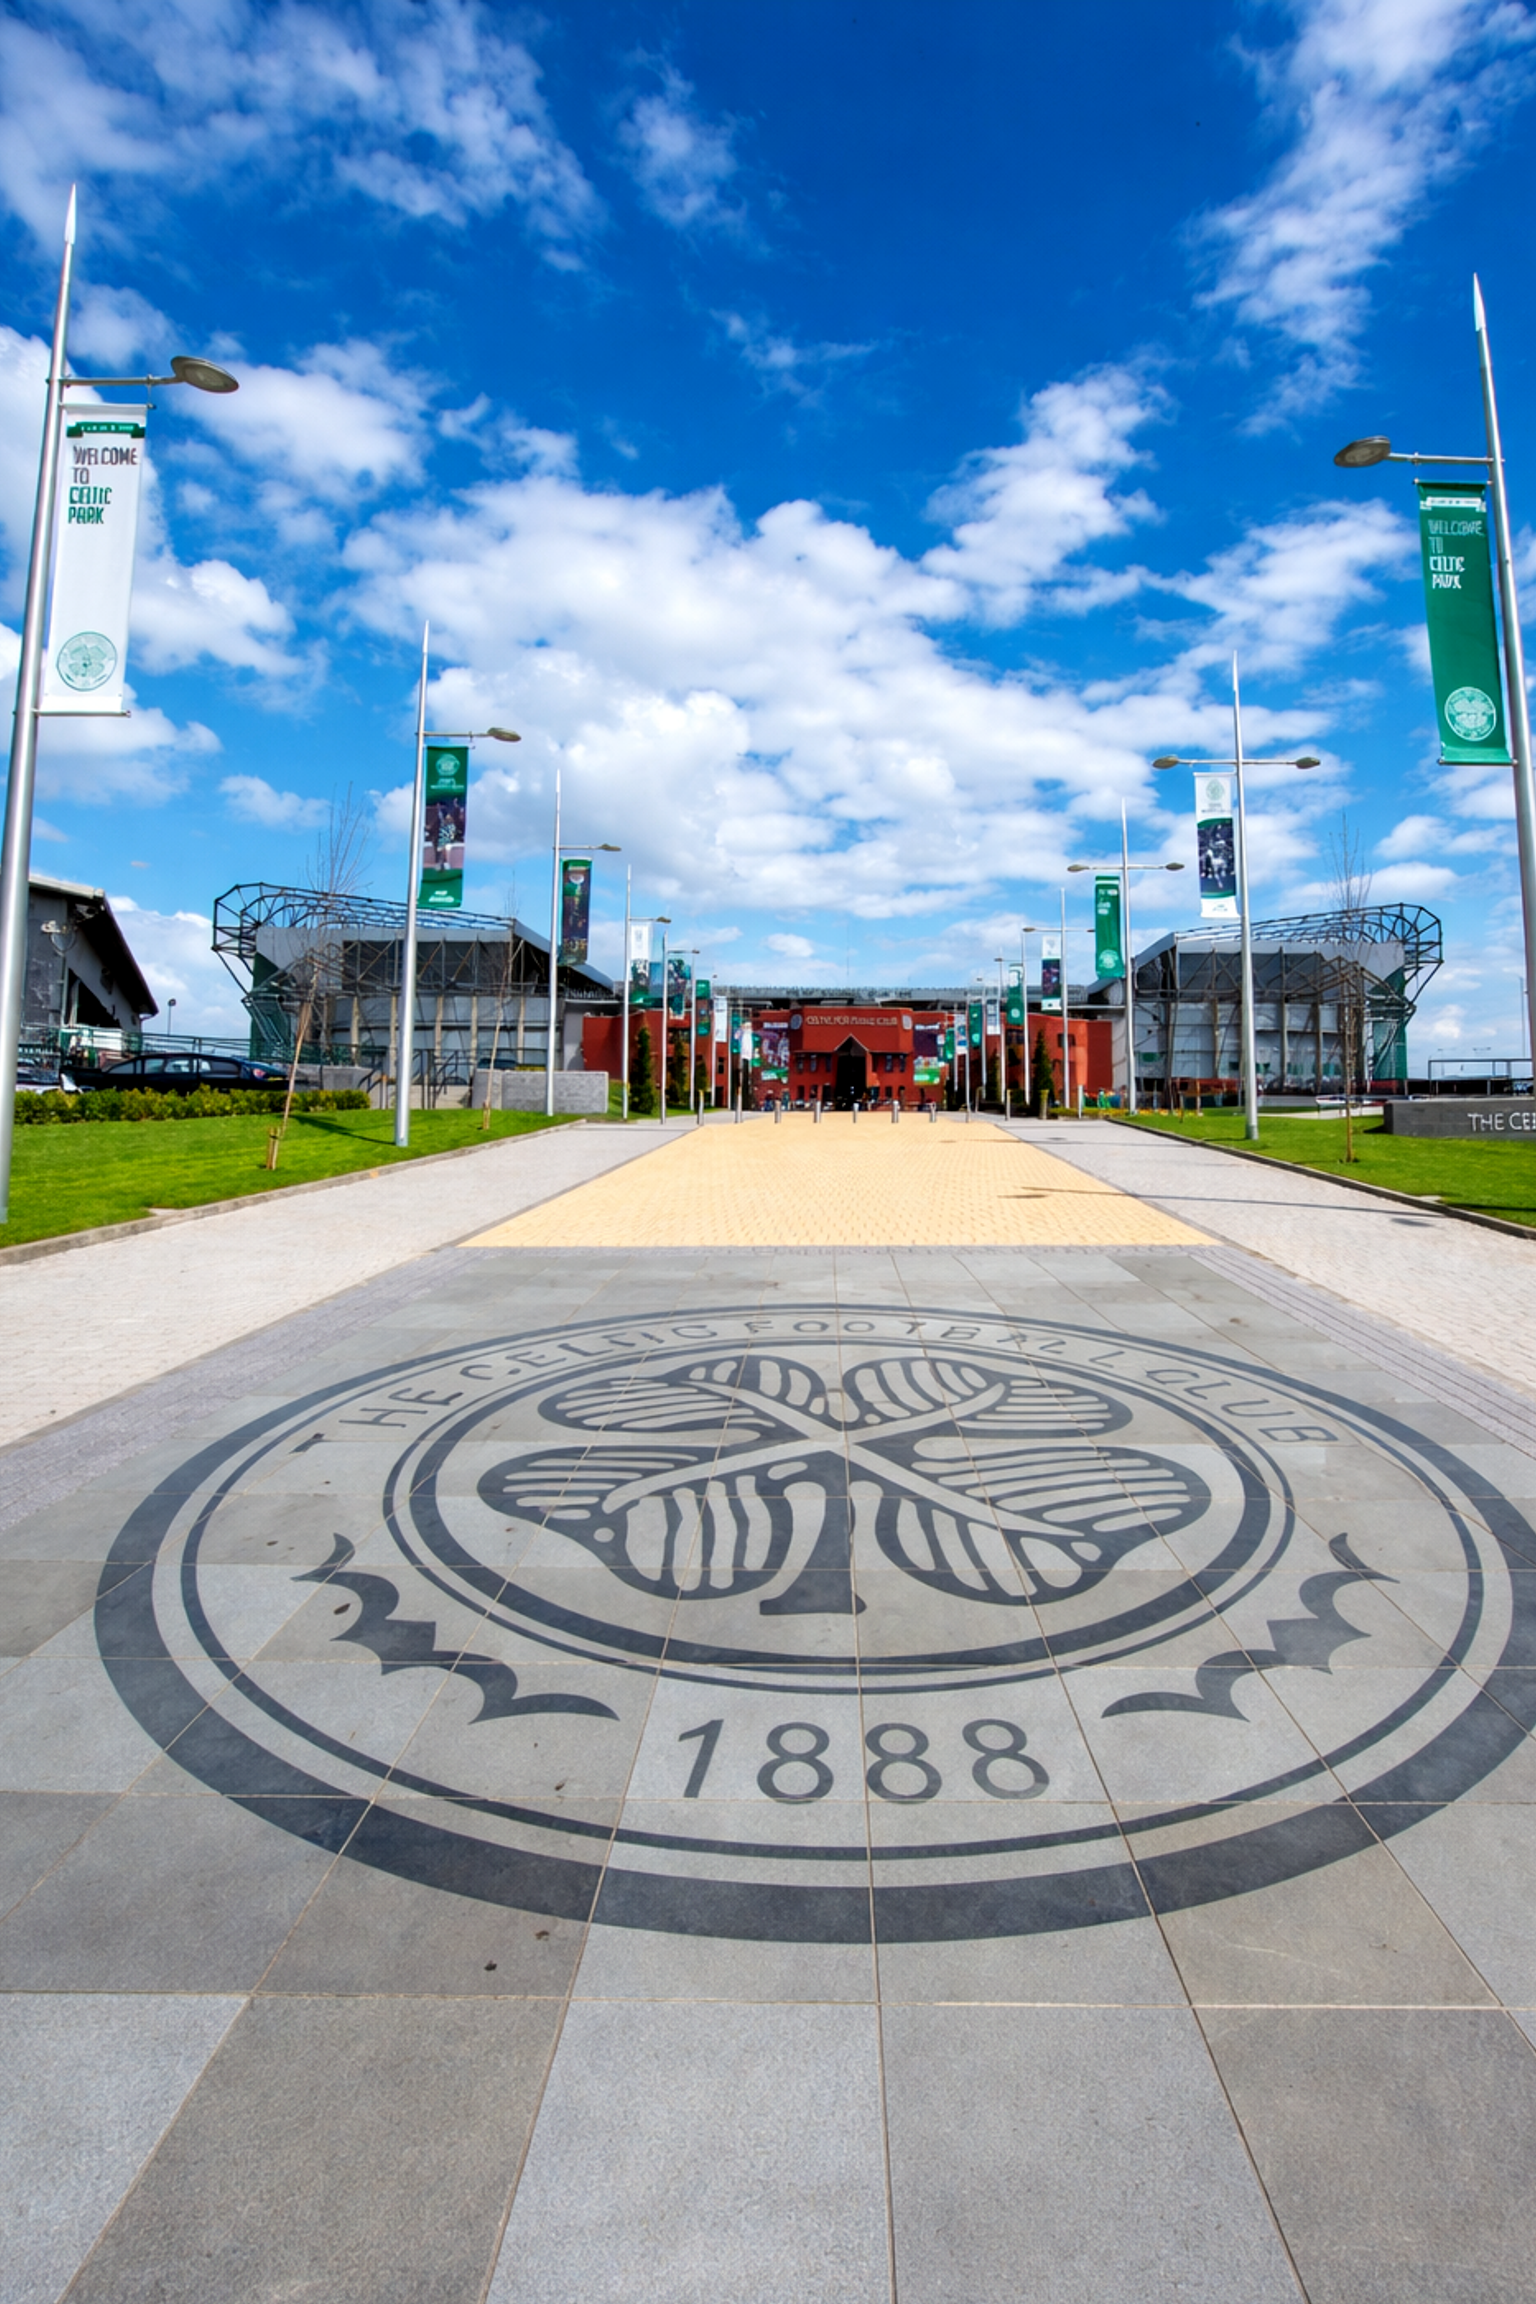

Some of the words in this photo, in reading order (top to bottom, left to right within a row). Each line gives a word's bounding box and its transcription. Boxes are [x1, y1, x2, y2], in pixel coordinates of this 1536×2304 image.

[72, 466, 90, 485] TO
[68, 506, 105, 525] PARK
[1467, 1113, 1505, 1132] THE
[1143, 1368, 1340, 1442] CLUB
[677, 1718, 1051, 1805] 1888
